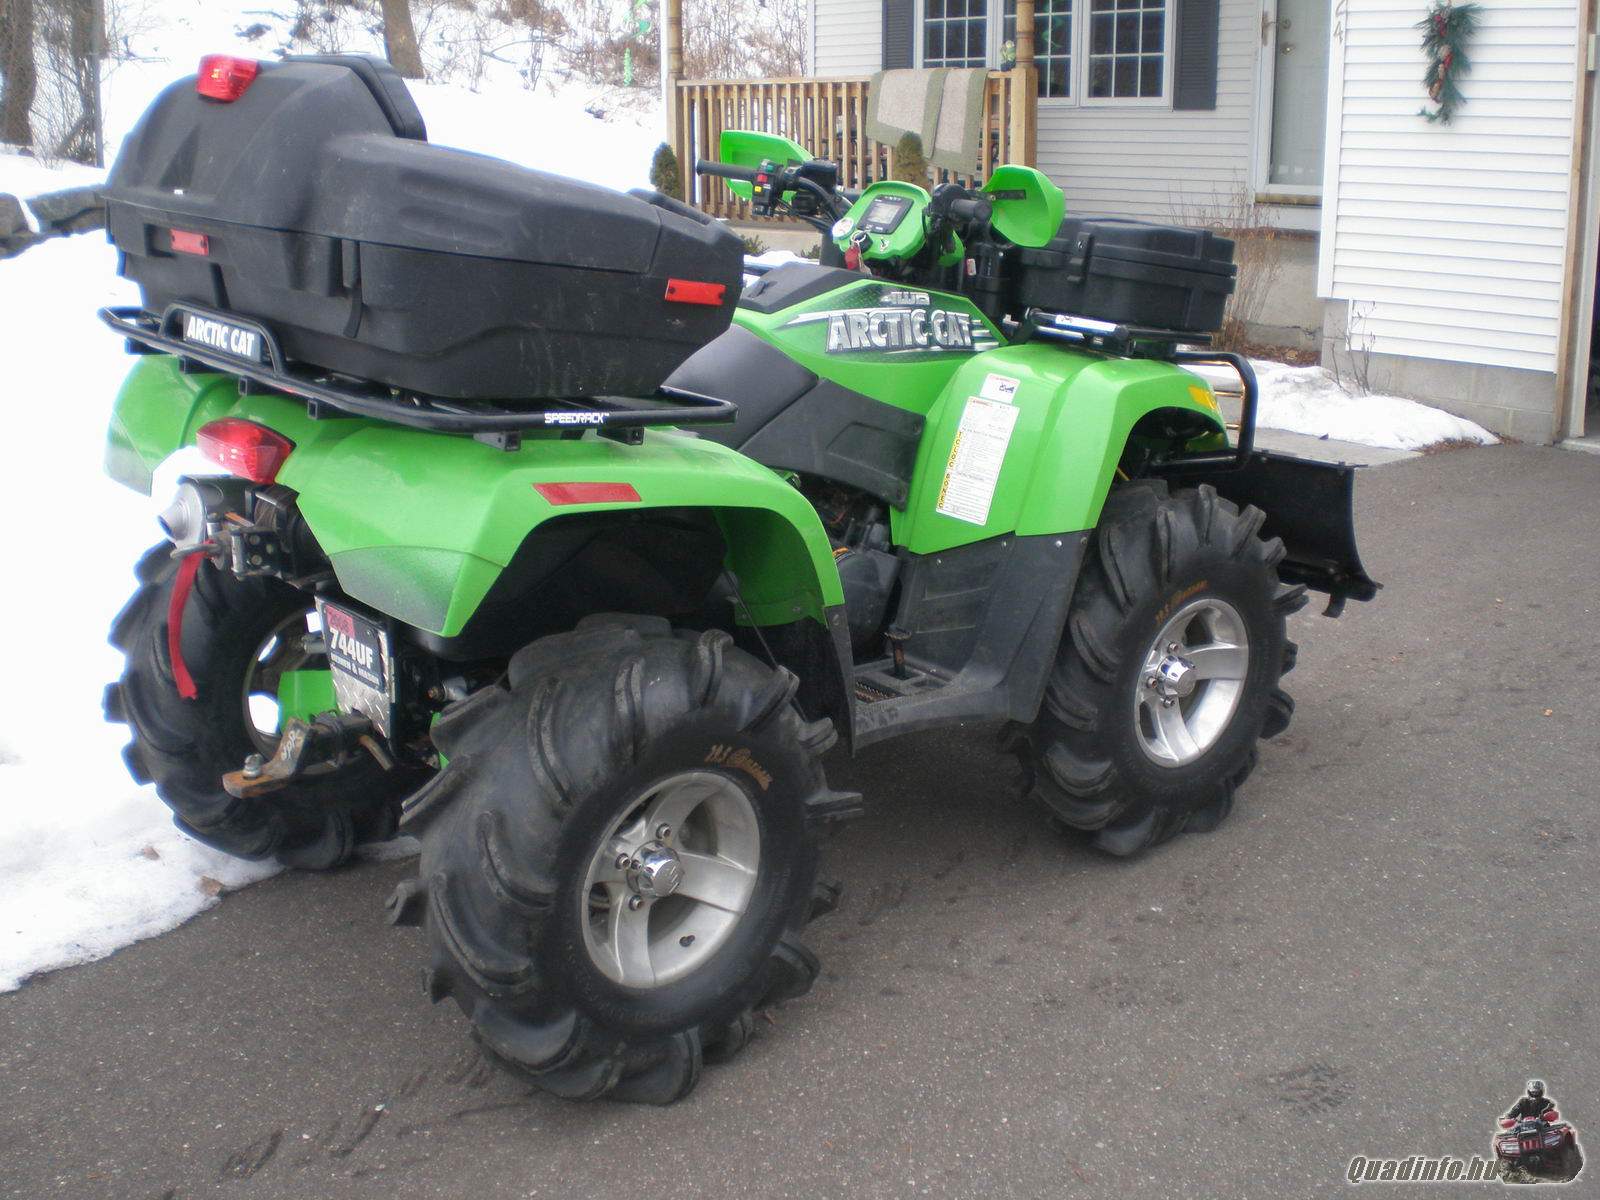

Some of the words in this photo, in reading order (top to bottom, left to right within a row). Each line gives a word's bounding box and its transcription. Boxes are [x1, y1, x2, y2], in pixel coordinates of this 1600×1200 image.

[187, 316, 229, 349] ARCTIC
[230, 328, 255, 357] CAT
[827, 309, 928, 352] ARCTIC
[931, 309, 972, 347] CAT
[330, 627, 373, 669] 744UF
